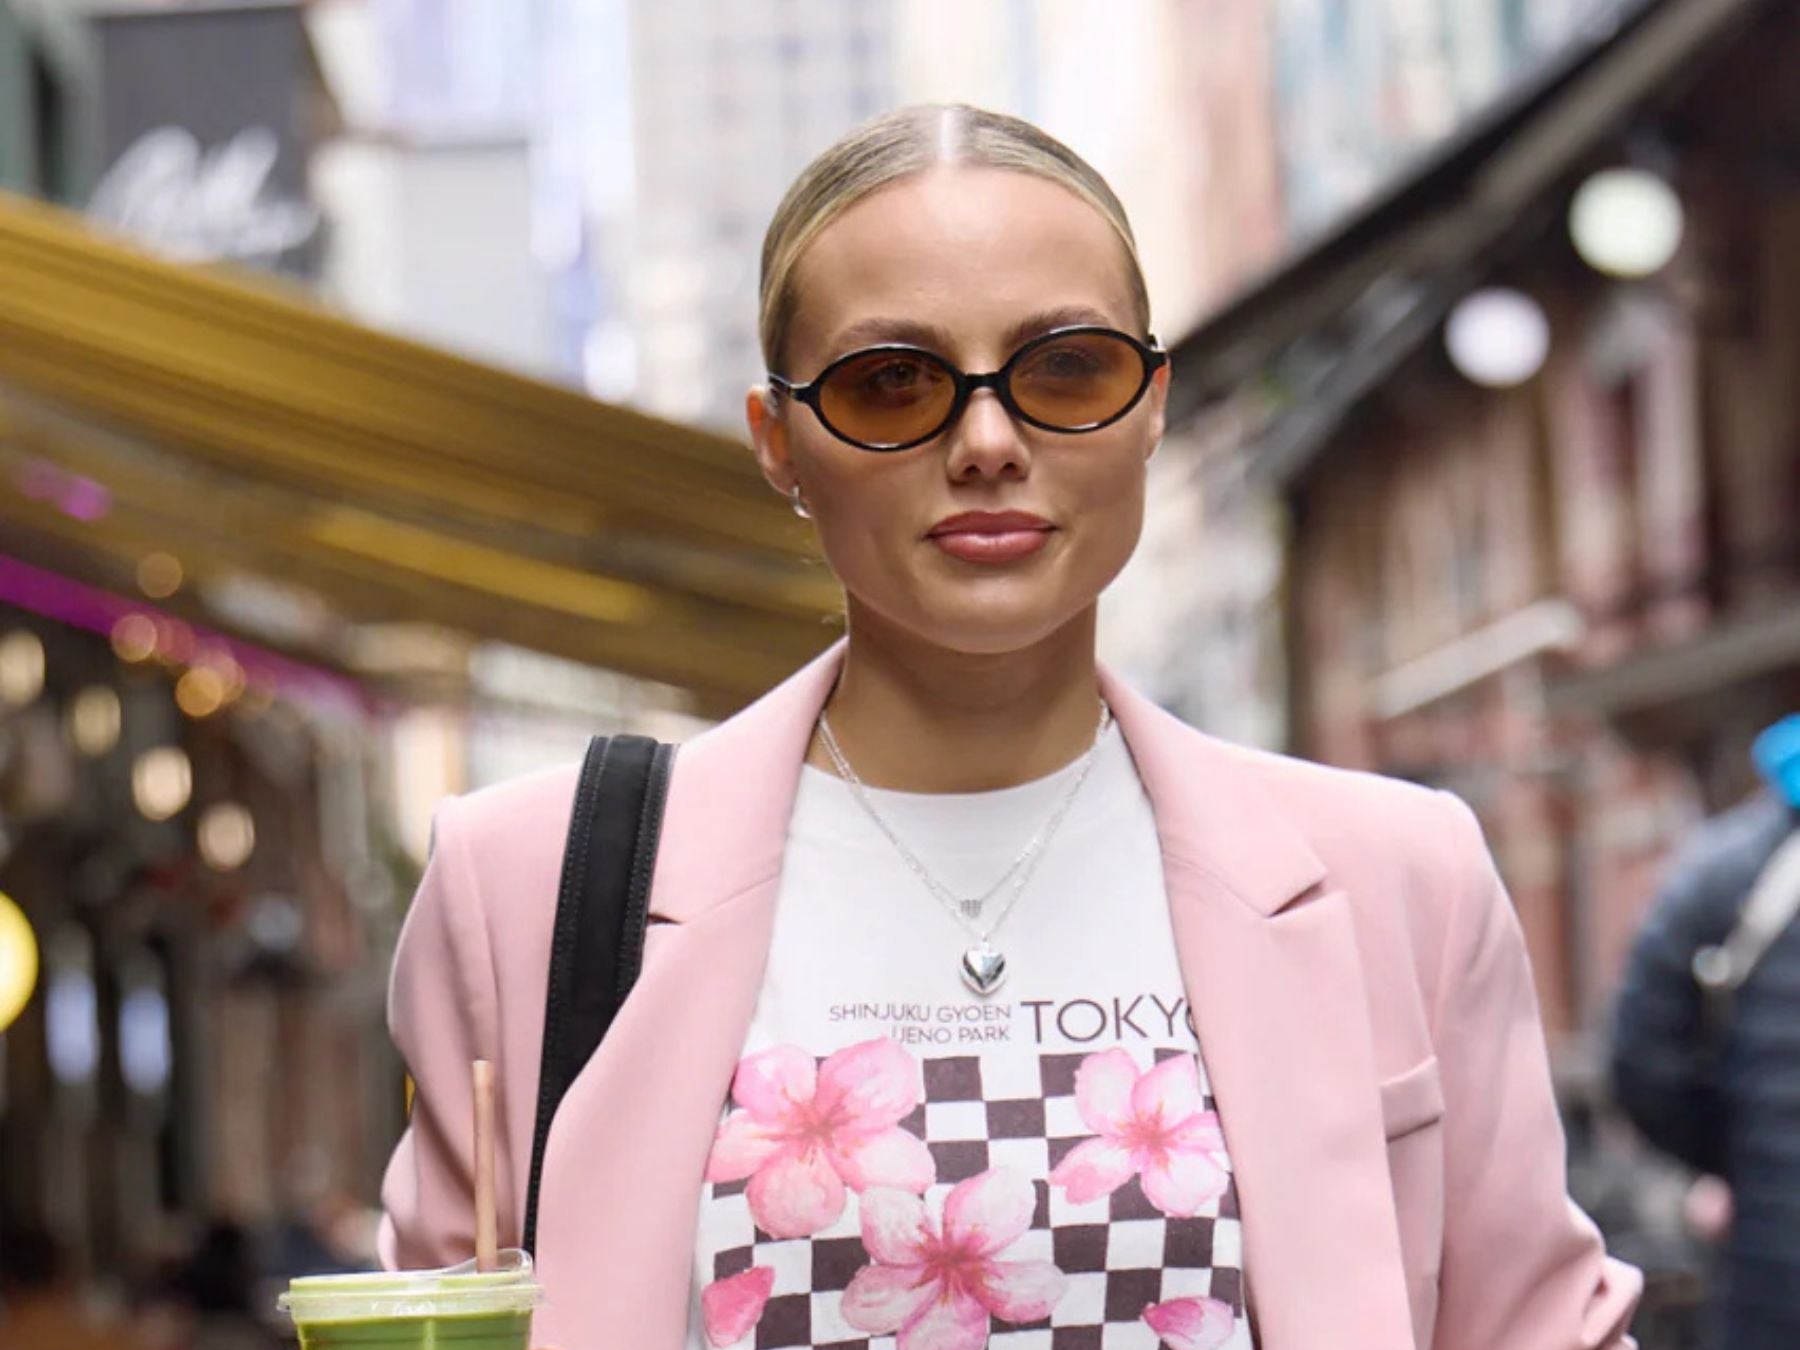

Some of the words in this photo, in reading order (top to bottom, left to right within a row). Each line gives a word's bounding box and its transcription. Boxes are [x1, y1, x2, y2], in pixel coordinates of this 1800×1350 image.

[829, 1003, 931, 1022] SHINJUKU
[936, 1004, 1011, 1023] GYOEN
[1020, 994, 1199, 1044] TOKY
[892, 1026, 952, 1044] UENO
[958, 1025, 1011, 1042] PARK
